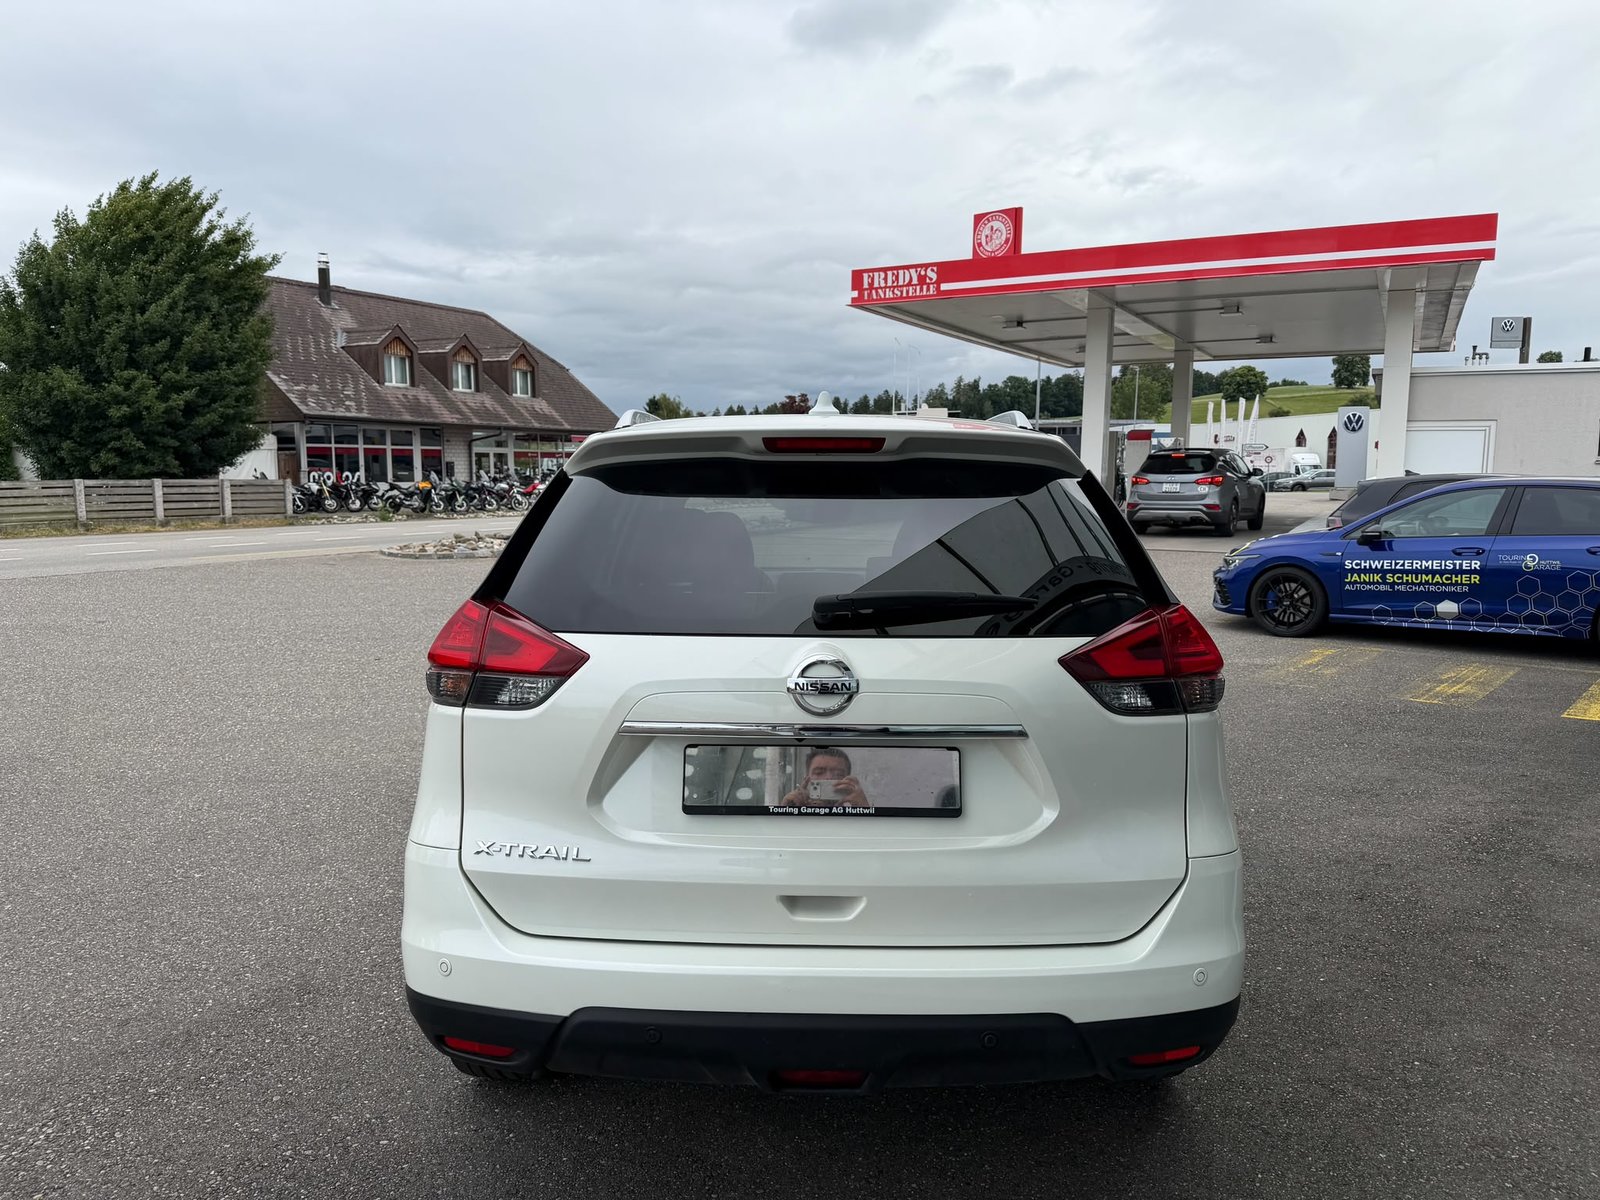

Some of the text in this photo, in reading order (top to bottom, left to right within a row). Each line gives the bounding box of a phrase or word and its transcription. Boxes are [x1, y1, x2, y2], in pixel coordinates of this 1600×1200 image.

[862, 266, 938, 289] FREDY'S
[863, 283, 937, 300] TANKSTELLE
[1344, 559, 1481, 570] SCHWEIZERMEISTER
[1344, 573, 1480, 584] JANIK SCHUMACHER
[1394, 585, 1469, 593] MECHATRONIKER
[794, 681, 852, 693] NISSAN
[769, 805, 875, 815] Touring Garage AG Huttwil
[473, 840, 592, 862] X-TRAIL
